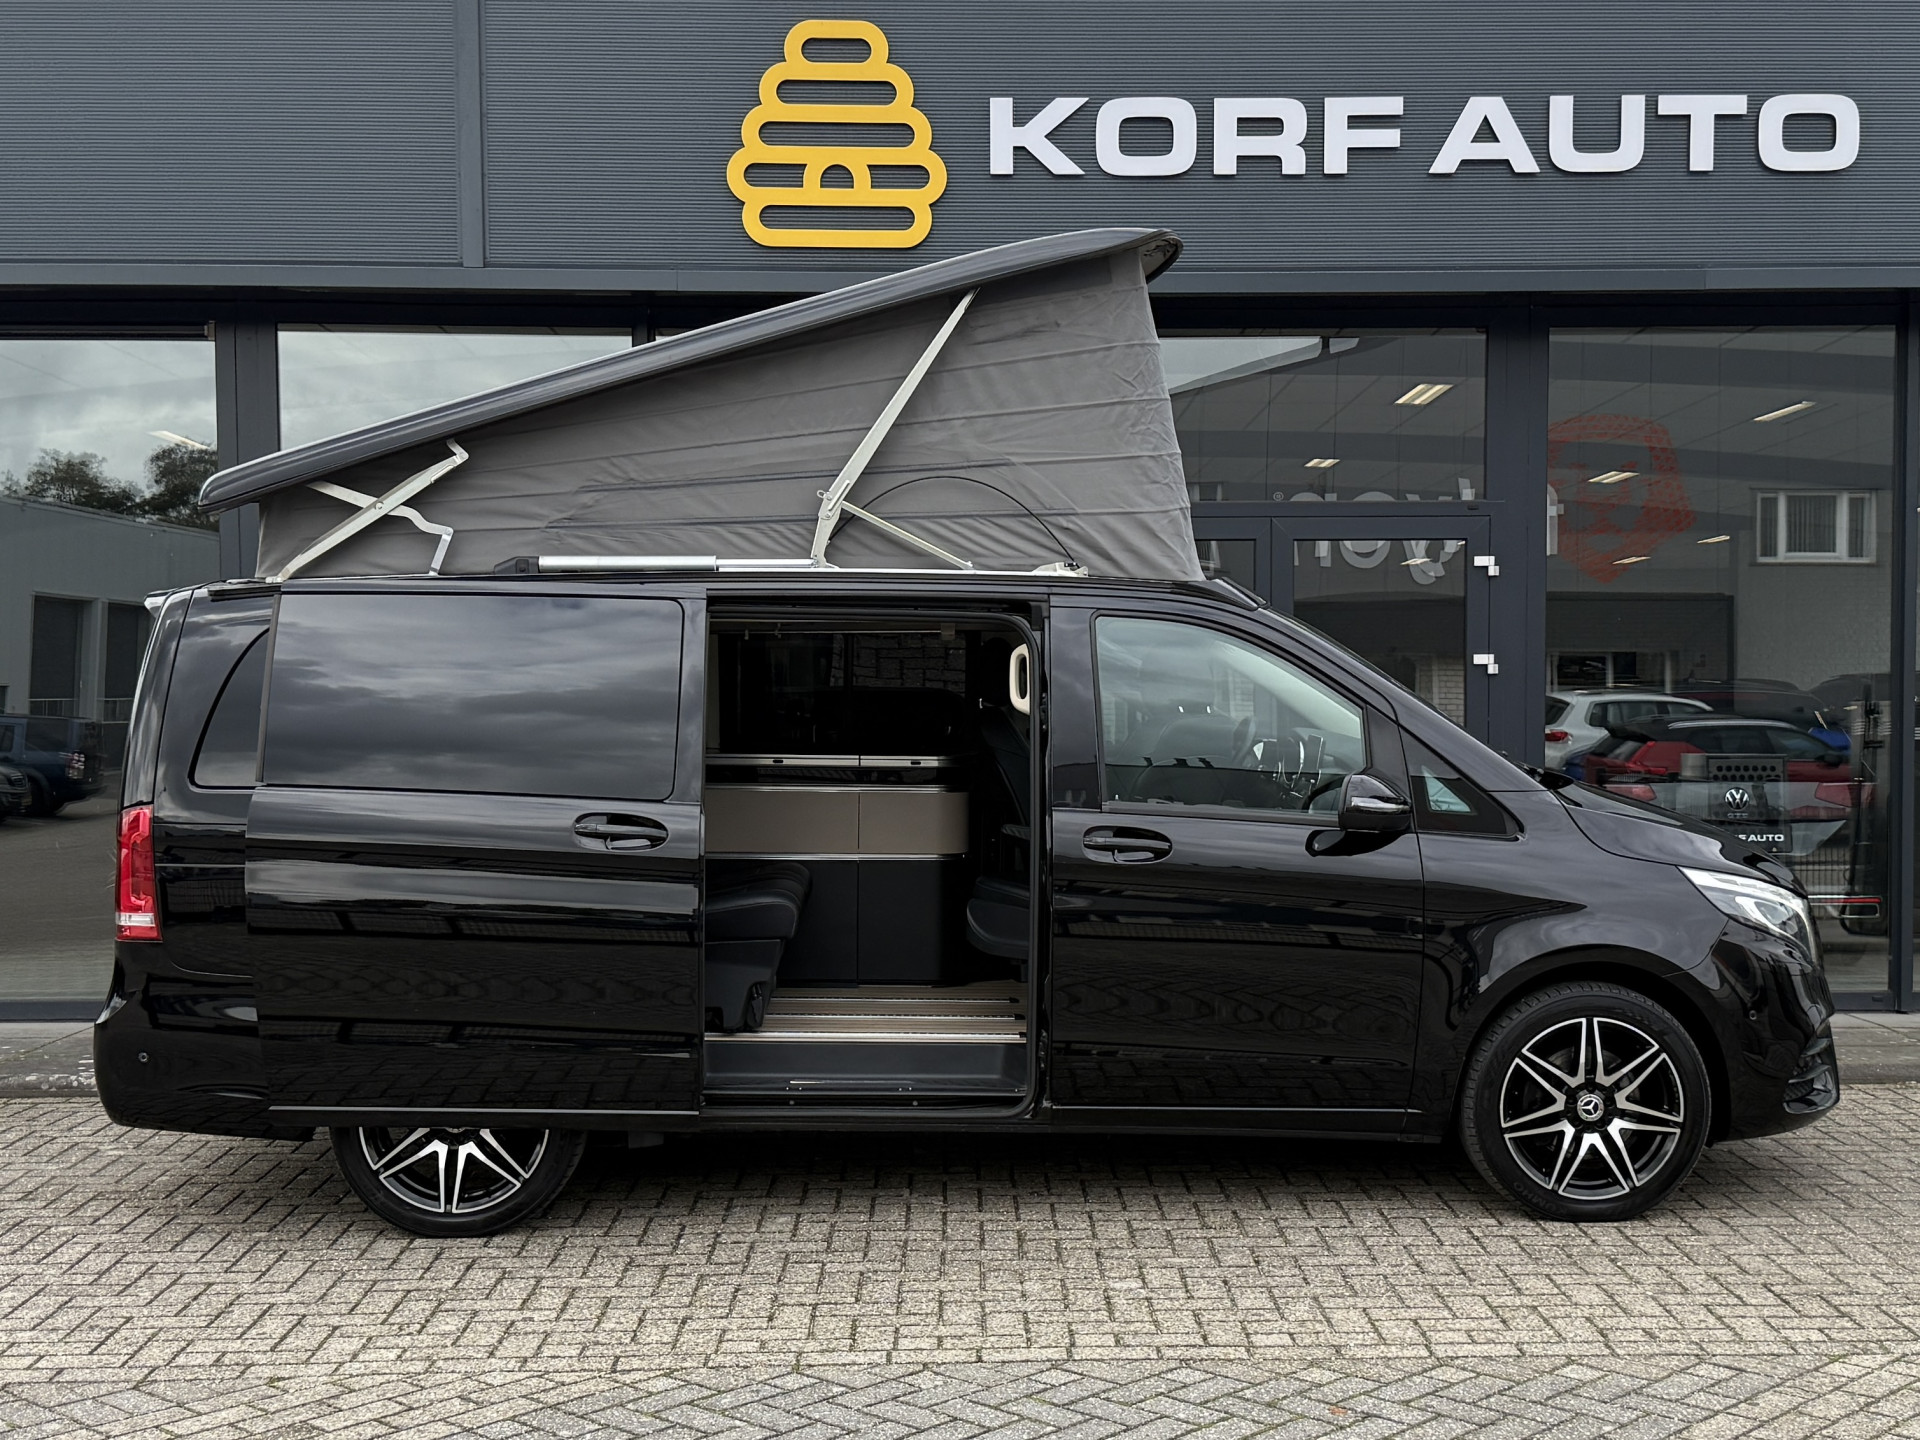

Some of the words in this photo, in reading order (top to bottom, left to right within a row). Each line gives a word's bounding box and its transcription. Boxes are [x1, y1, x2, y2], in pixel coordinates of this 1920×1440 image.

[989, 96, 1404, 176] KORF
[1429, 93, 1860, 174] AUTO
[1512, 1181, 1569, 1216] KUMHO
